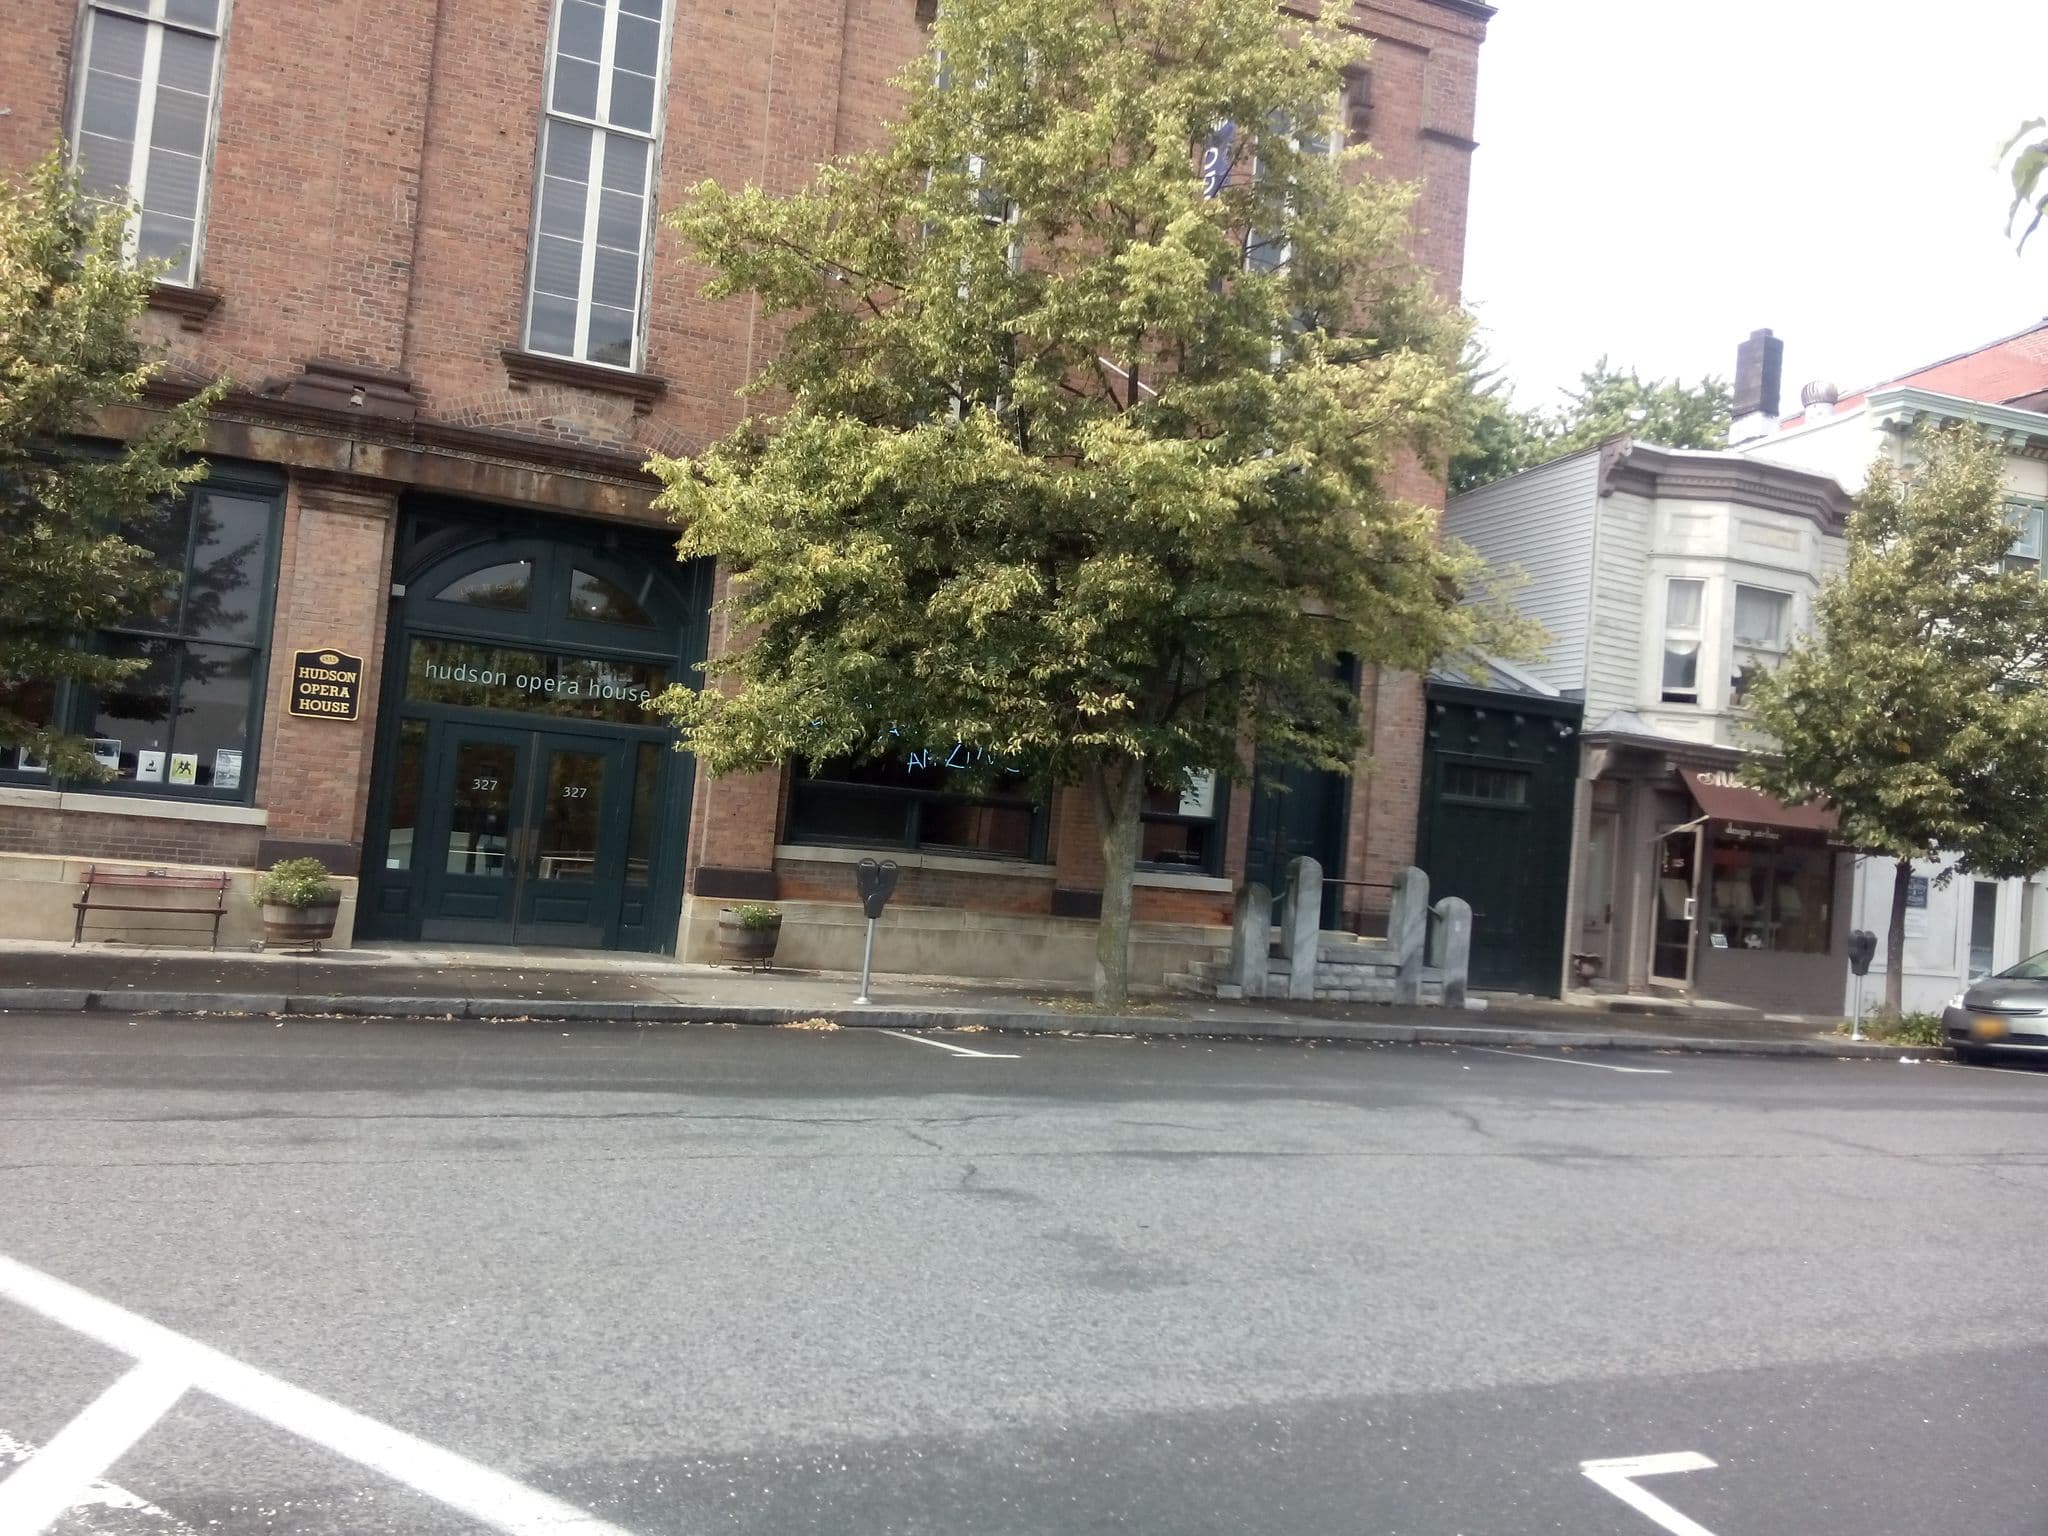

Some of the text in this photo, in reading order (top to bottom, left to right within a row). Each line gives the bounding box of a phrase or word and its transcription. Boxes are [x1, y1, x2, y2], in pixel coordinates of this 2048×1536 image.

[299, 667, 357, 683] HUDSON
[425, 660, 651, 701] hudson opera house
[300, 683, 350, 698] OPERA
[299, 698, 350, 714] HOUSE
[472, 778, 498, 791] 327
[562, 786, 588, 798] 327
